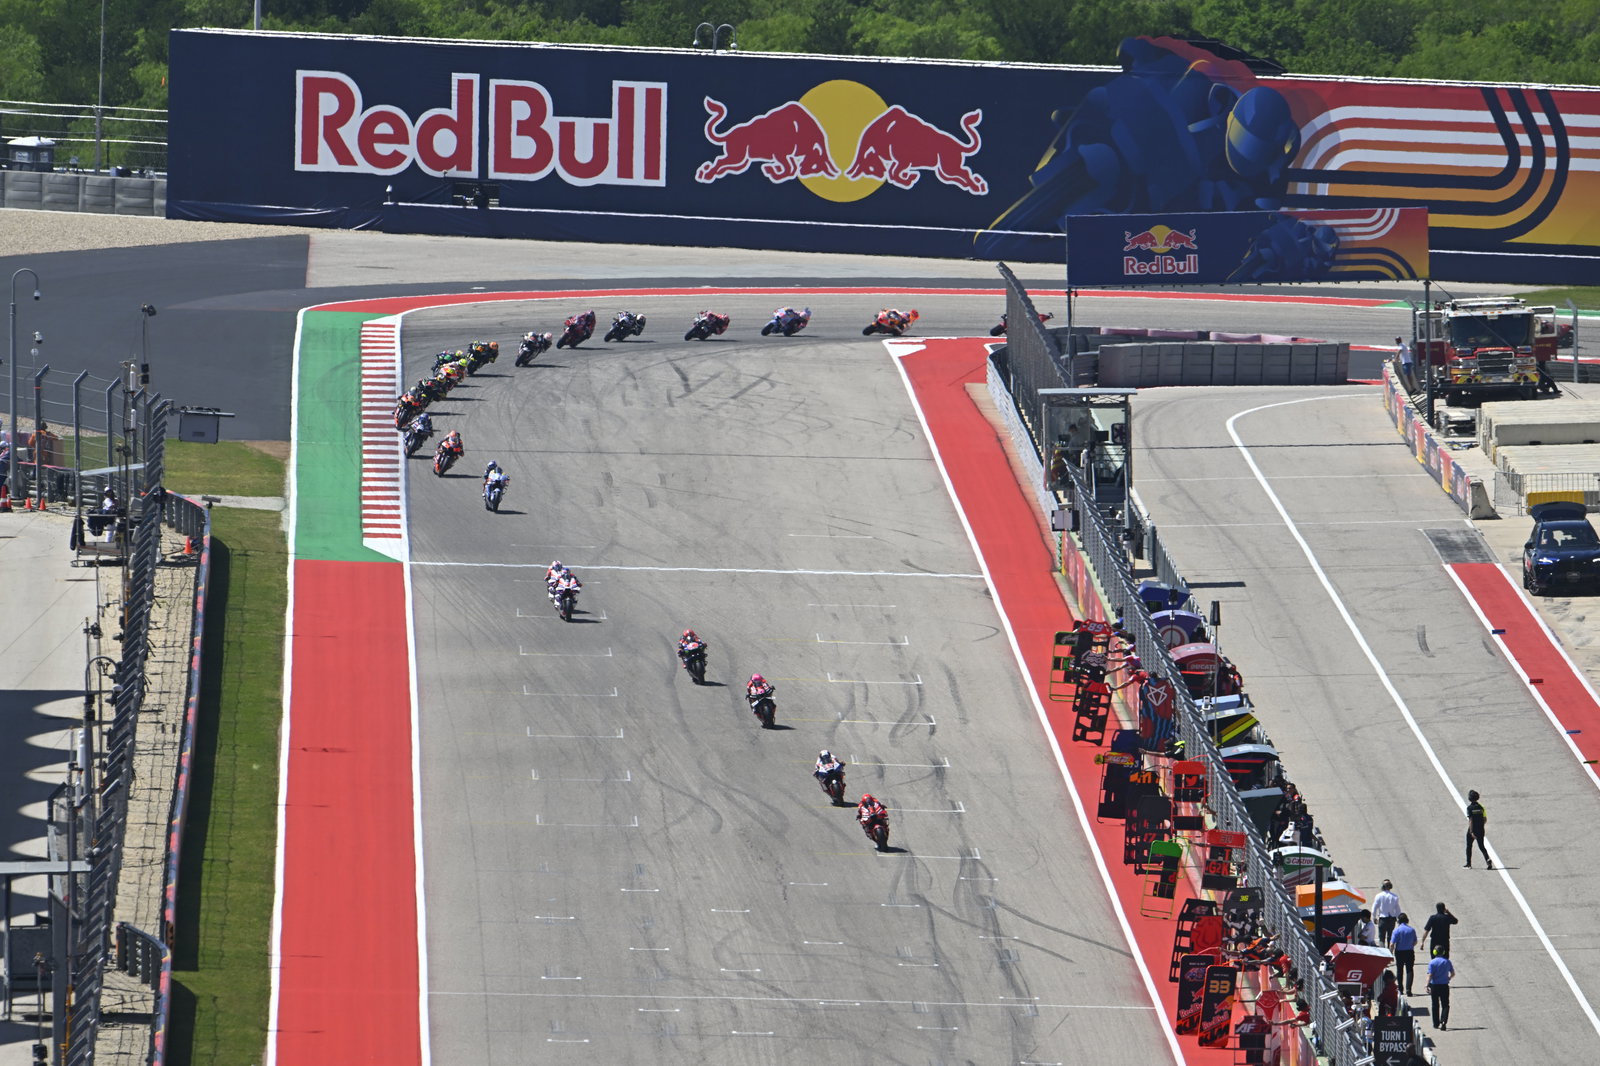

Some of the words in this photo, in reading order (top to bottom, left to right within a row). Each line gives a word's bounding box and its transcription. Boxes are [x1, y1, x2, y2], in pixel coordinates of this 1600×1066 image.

[295, 70, 480, 178] Red
[488, 78, 667, 187] Bull
[1124, 256, 1160, 275] Red
[1162, 254, 1198, 274] Bull
[1291, 857, 1313, 865] Castrol
[1209, 980, 1231, 994] 33
[1200, 1021, 1230, 1046] KTM
[1381, 1030, 1400, 1041] TURN
[1403, 1030, 1406, 1040] 1
[1380, 1042, 1407, 1053] BYPASS
